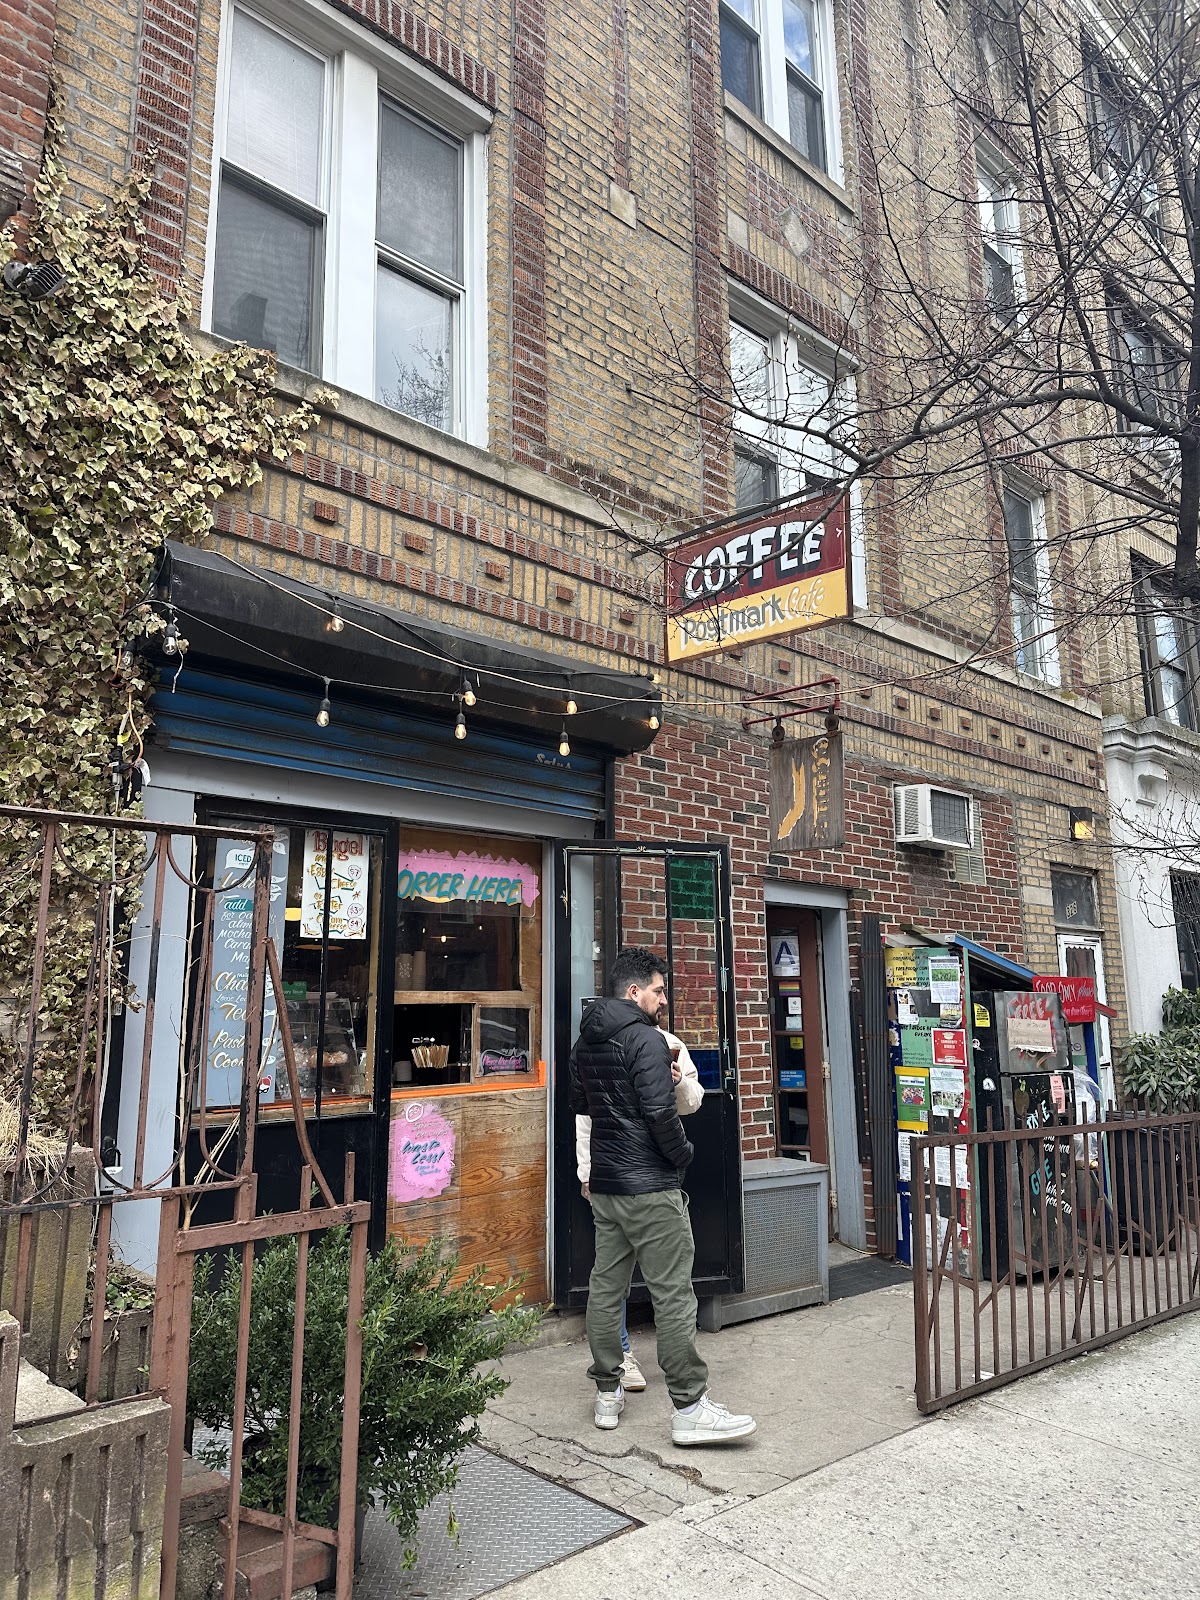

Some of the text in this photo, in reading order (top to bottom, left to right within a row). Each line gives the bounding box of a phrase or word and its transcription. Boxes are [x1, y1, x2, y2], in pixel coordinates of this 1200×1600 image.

[683, 519, 826, 602] COFFEE
[680, 593, 785, 650] Postmark
[235, 853, 252, 863] ICED
[397, 869, 523, 907] ORDER HERE
[224, 899, 248, 911] add
[774, 940, 796, 965] A
[214, 971, 249, 992] Cha
[1026, 1099, 1051, 1130] TAE
[402, 1140, 441, 1155] Waste
[411, 1149, 446, 1165] Less!
